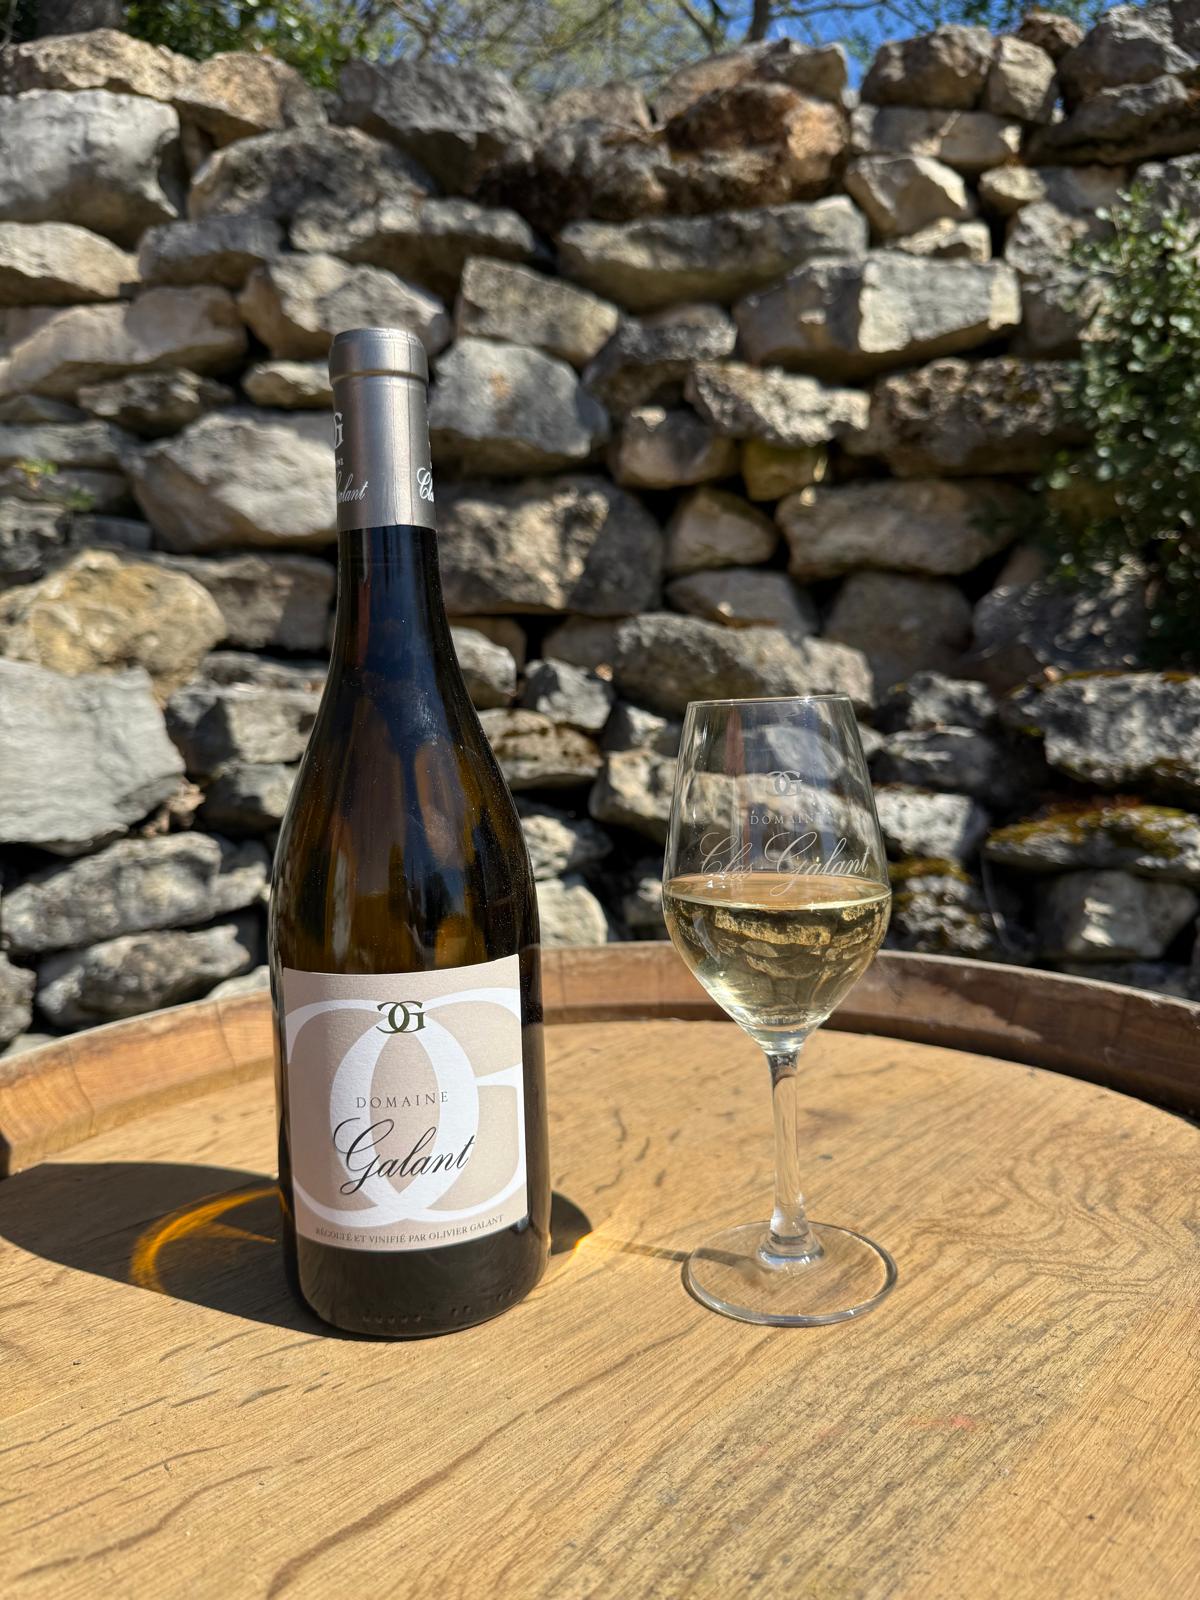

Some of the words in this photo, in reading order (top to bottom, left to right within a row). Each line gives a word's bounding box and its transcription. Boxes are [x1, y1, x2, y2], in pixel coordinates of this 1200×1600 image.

[336, 471, 369, 504] alant
[700, 832, 753, 881] Clos
[765, 832, 870, 897] Galant
[355, 1091, 450, 1110] DOMAINE
[333, 1117, 476, 1196] Galant
[354, 1233, 367, 1244] ET
[369, 1231, 407, 1244] VINIFIÉ
[408, 1232, 426, 1243] PAR
[428, 1224, 468, 1241] OLIVIER
[469, 1214, 504, 1233] GALANT
